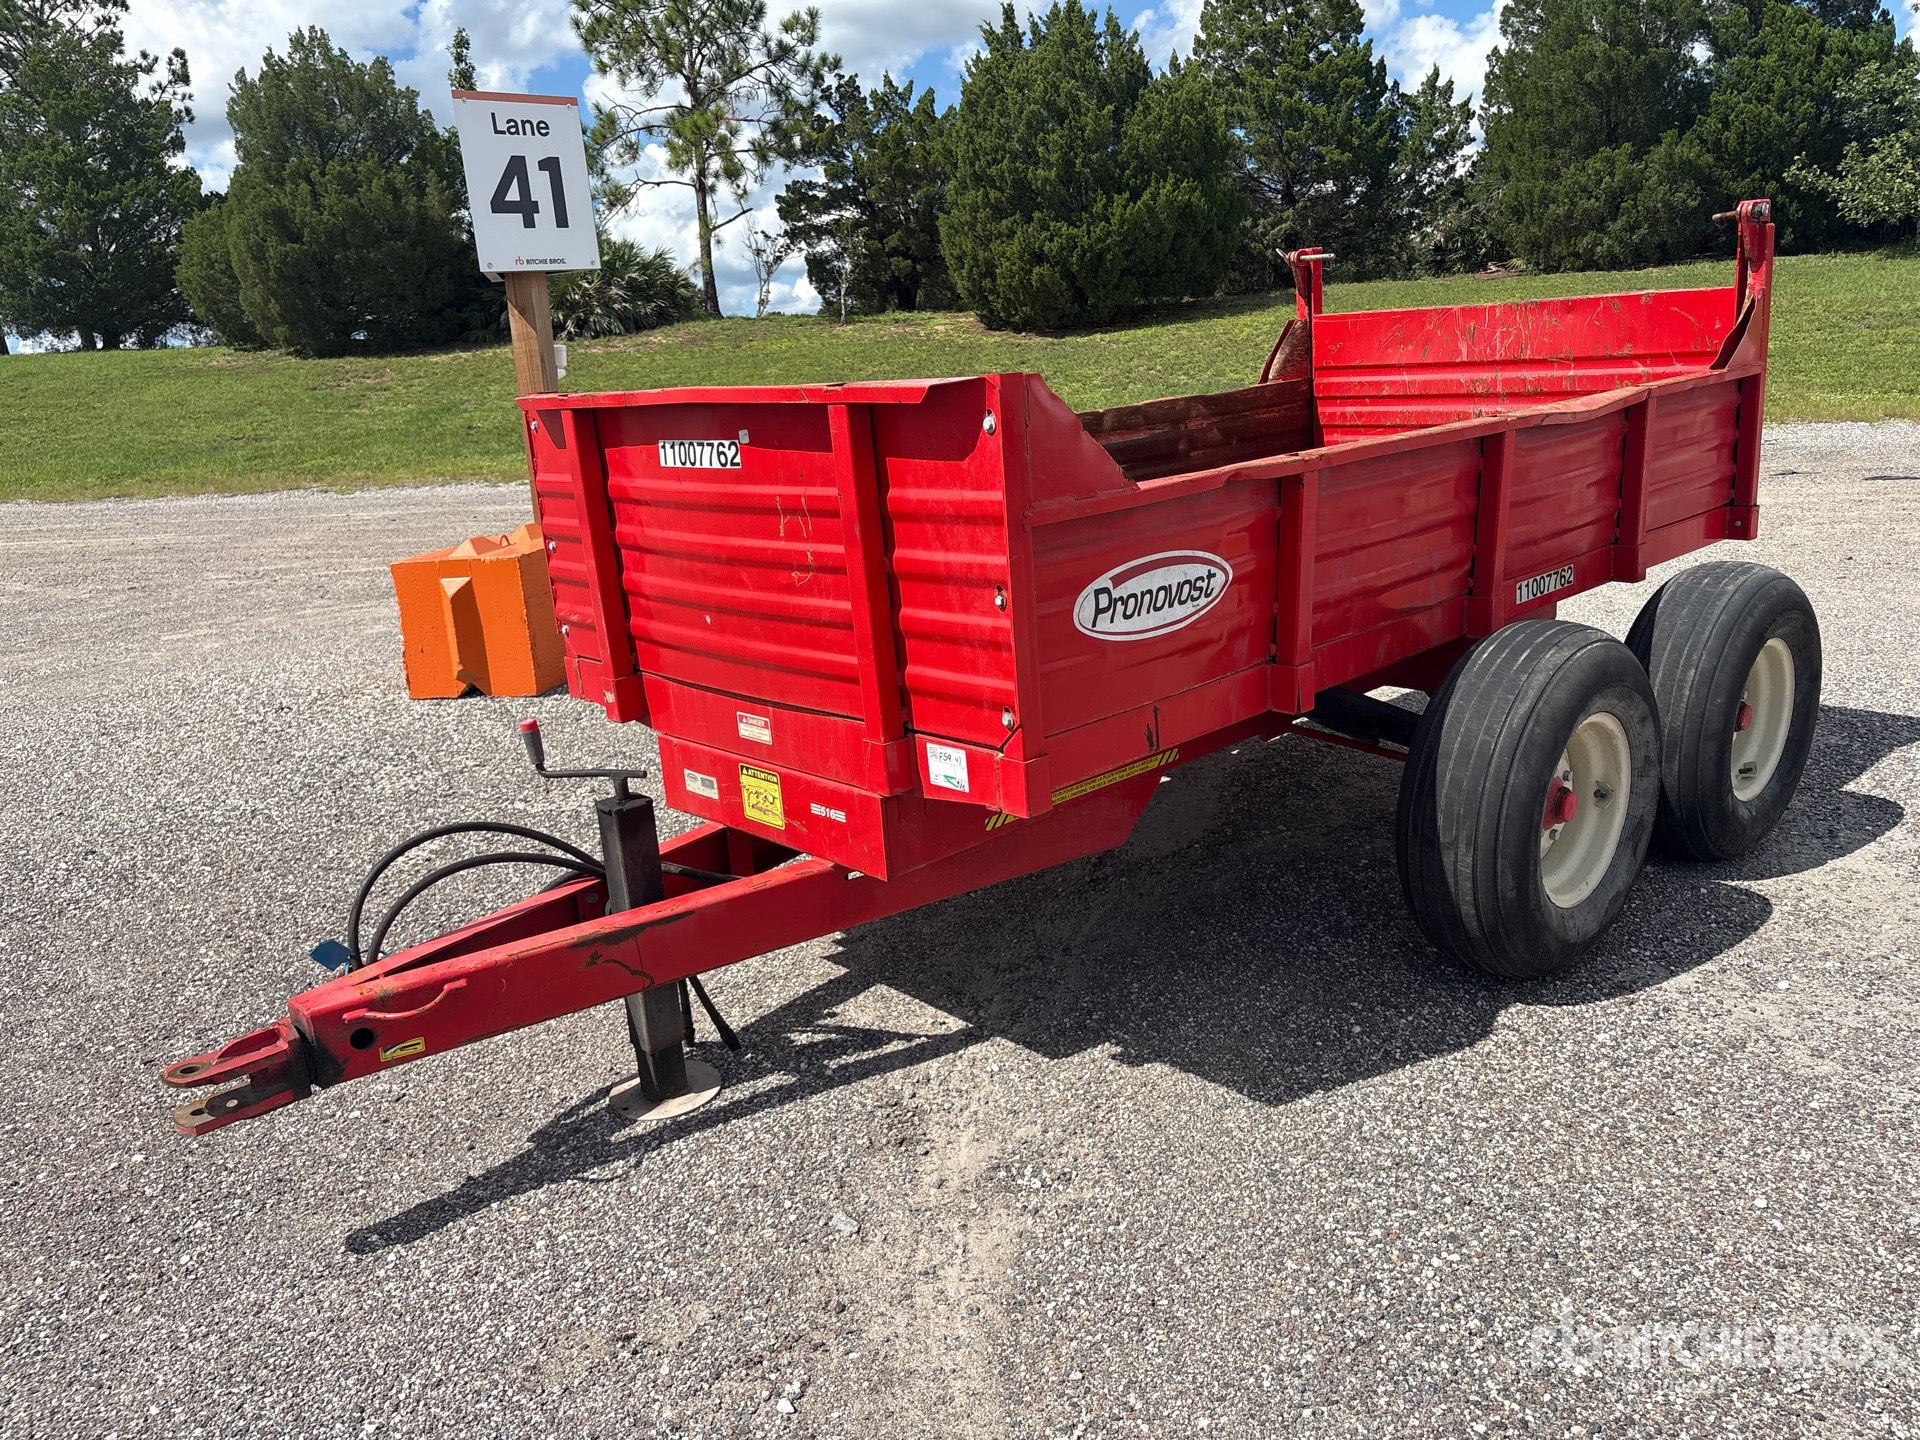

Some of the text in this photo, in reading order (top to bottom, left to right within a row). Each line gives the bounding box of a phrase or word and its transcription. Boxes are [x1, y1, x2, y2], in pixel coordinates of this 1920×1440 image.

[490, 112, 550, 137] Lane
[490, 155, 570, 229] 41
[661, 441, 741, 467] 11007762
[1517, 565, 1573, 602] 11007762
[1091, 568, 1217, 629] Pronovost
[747, 717, 765, 727] DANGER
[747, 769, 778, 783] ATTENTION
[820, 806, 836, 820] 516
